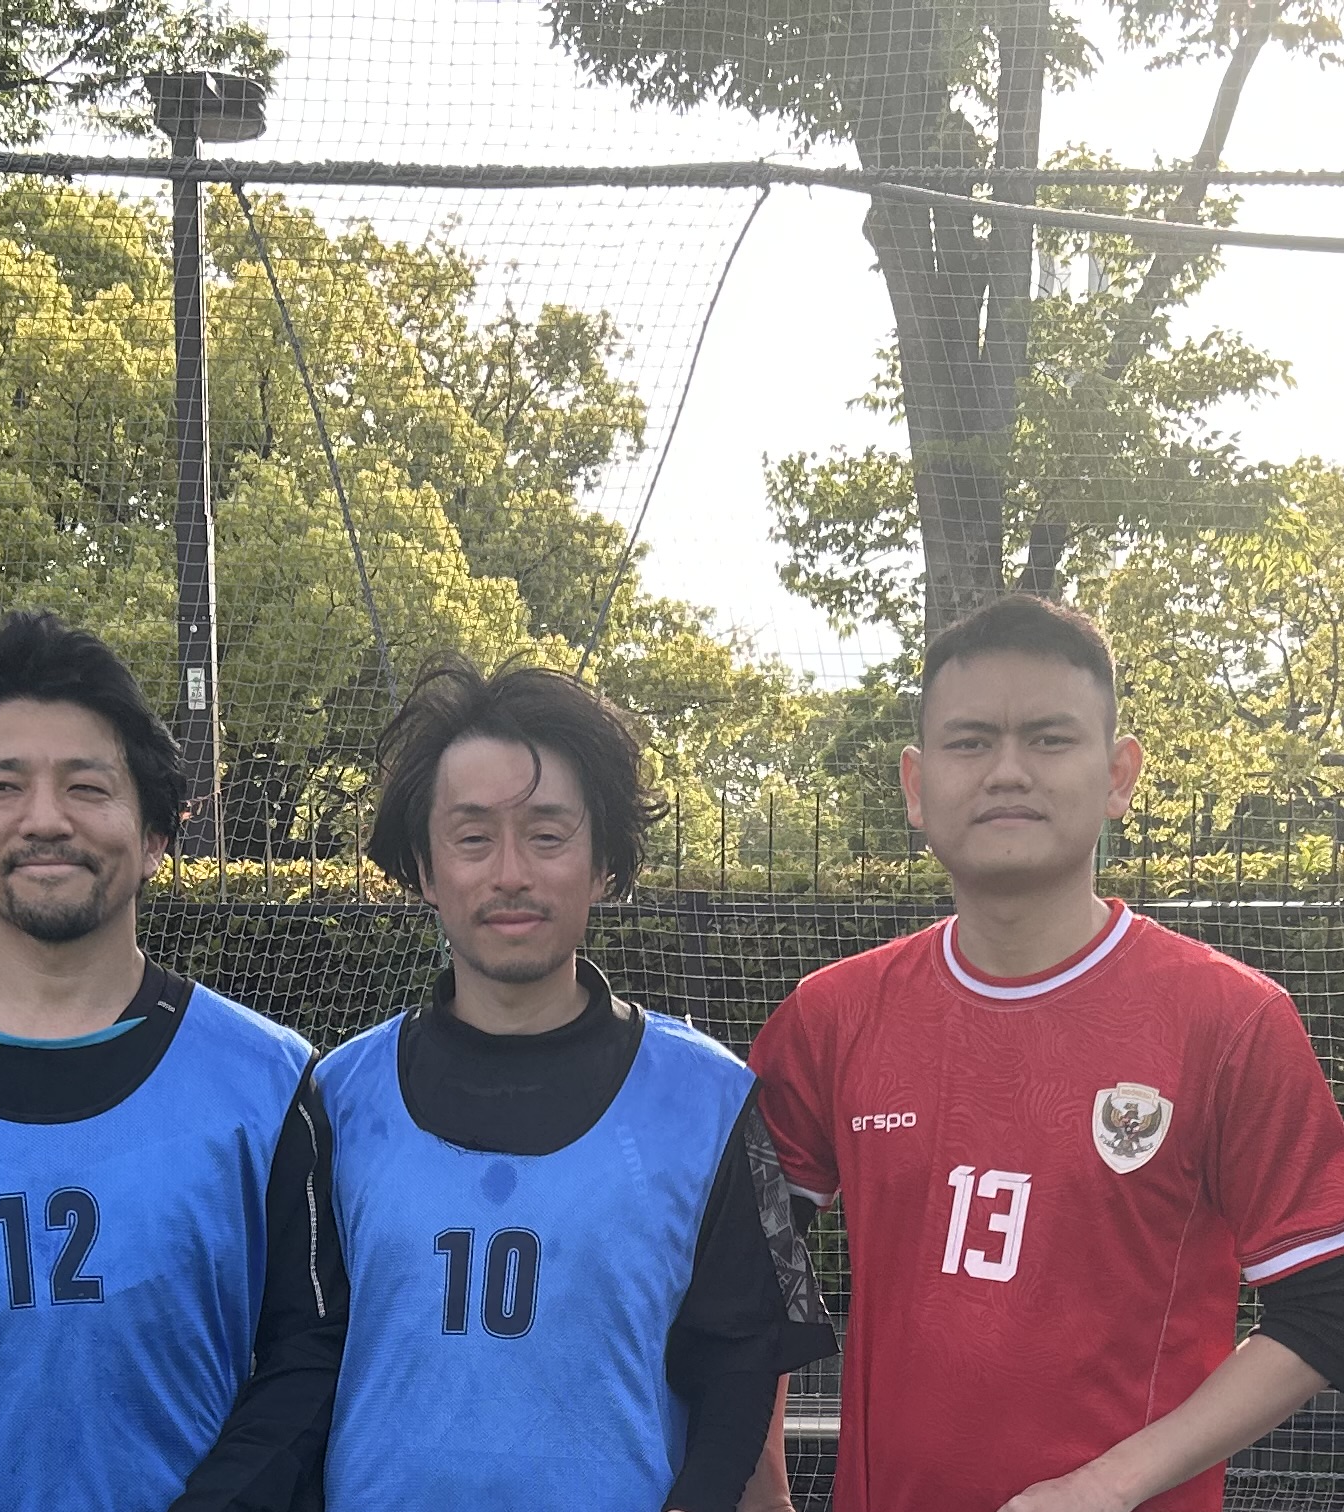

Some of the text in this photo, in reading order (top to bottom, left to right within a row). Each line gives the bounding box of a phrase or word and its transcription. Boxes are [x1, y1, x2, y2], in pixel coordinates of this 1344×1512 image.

[851, 1110, 917, 1133] erspo
[941, 1164, 1032, 1282] 13
[433, 1226, 542, 1340] 10
